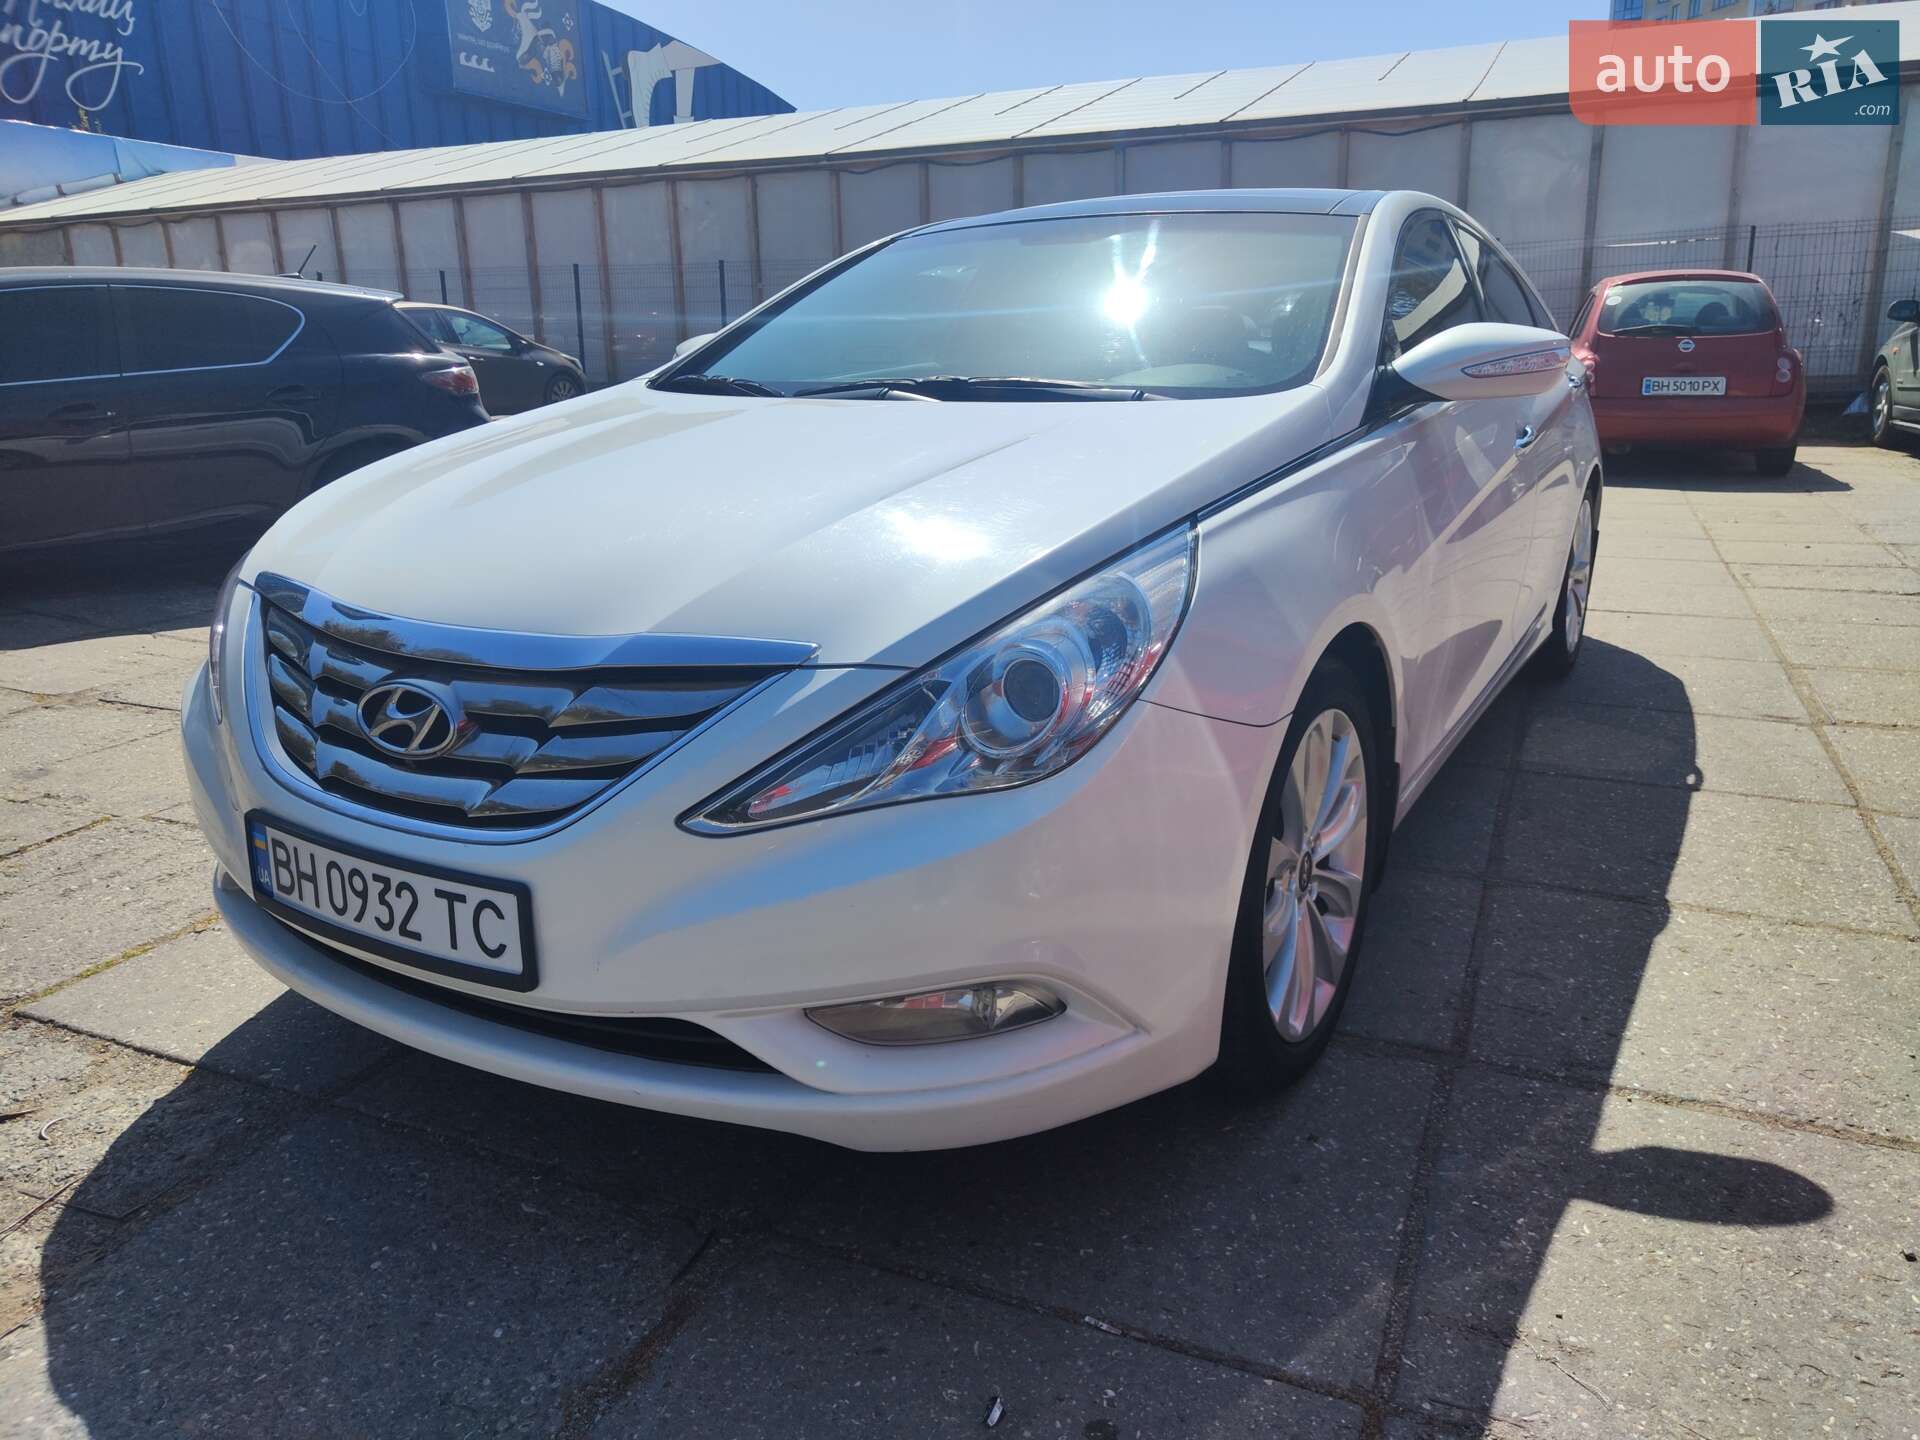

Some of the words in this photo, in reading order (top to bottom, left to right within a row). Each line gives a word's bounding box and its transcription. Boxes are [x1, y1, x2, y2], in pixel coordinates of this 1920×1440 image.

[1652, 380, 1670, 392] BH
[1673, 380, 1700, 392] 5010
[1702, 380, 1720, 392] PX
[434, 888, 507, 958] TC
